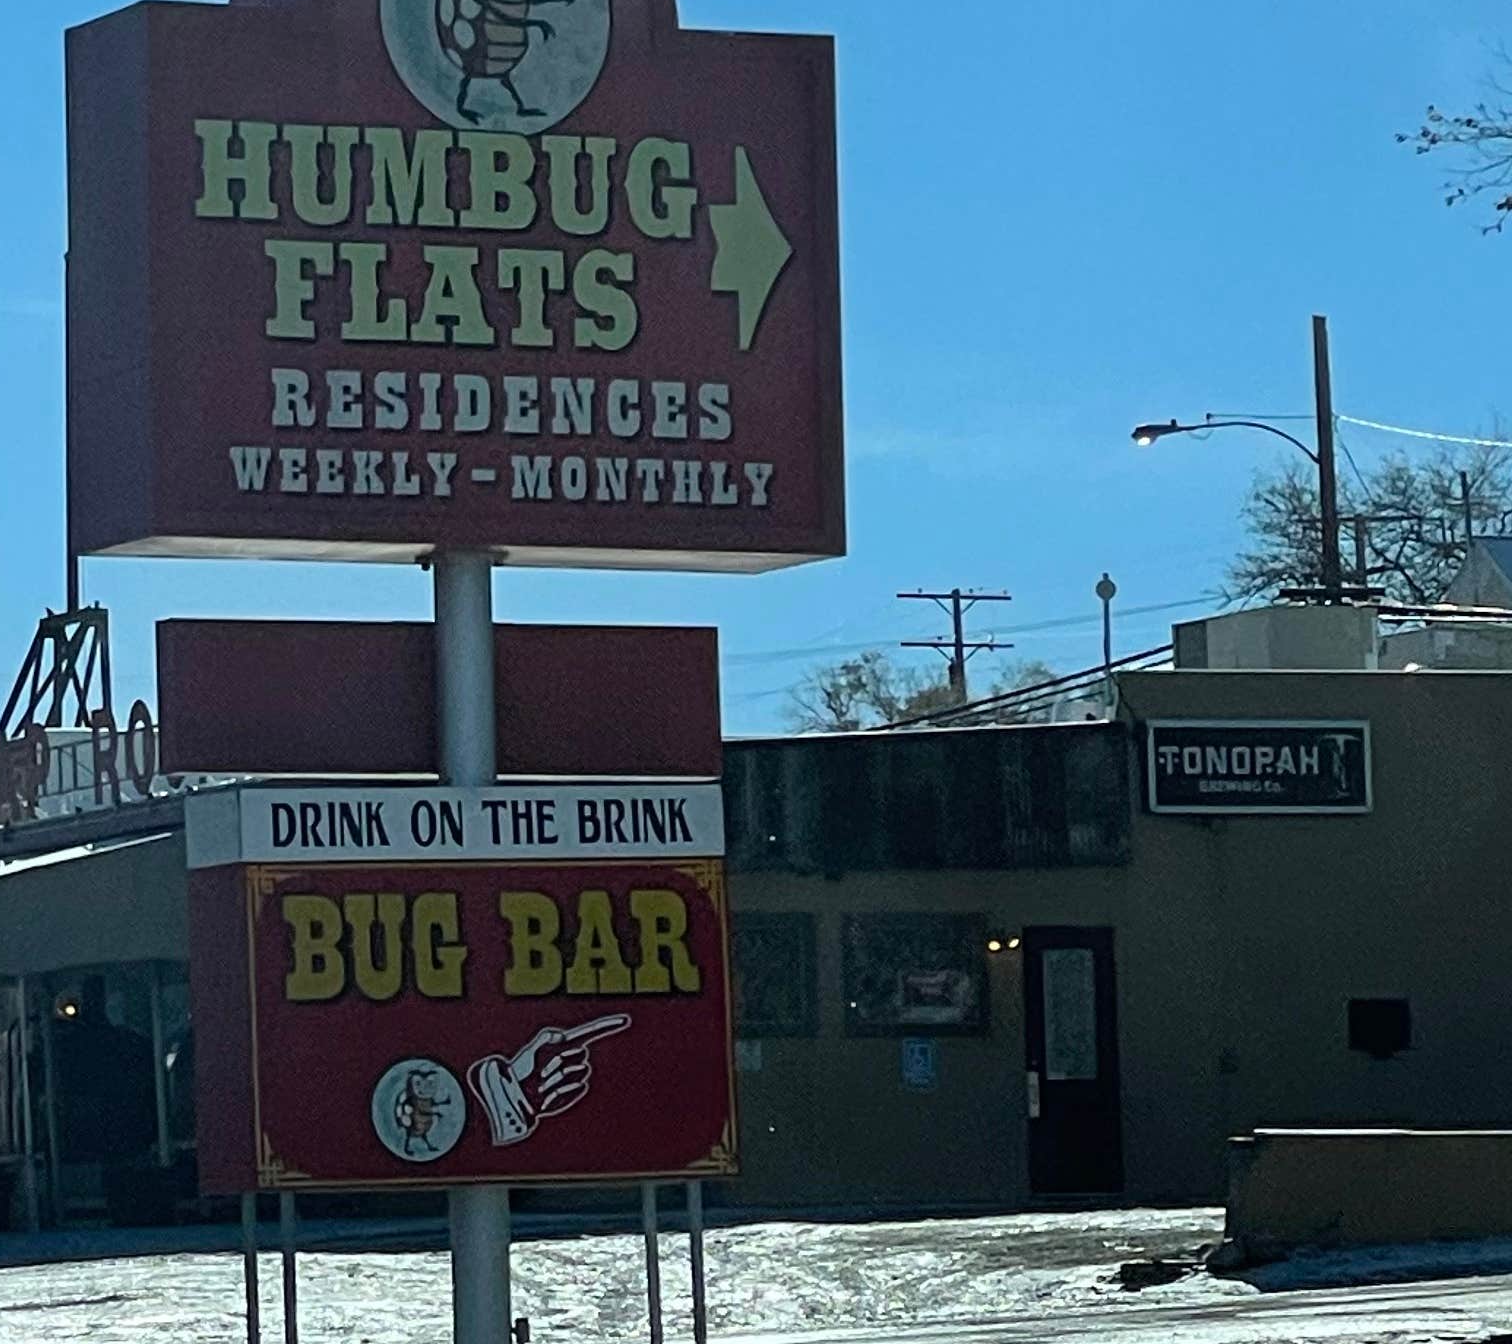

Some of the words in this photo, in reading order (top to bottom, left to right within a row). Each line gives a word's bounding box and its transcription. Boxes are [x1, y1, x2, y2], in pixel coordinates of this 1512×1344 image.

[194, 119, 697, 239] HUMBUG
[264, 239, 638, 351] FLATS
[271, 368, 732, 440] RESIDENCES
[229, 447, 457, 497] WEEKLY
[511, 456, 773, 506] MONTHLY
[1158, 745, 1319, 775] TONOPAH
[271, 801, 390, 848] DRINK
[410, 799, 463, 848] ON
[482, 798, 559, 845] THE
[577, 797, 693, 844] BRINK
[282, 892, 468, 1000] BUG
[500, 889, 701, 996] BAR
